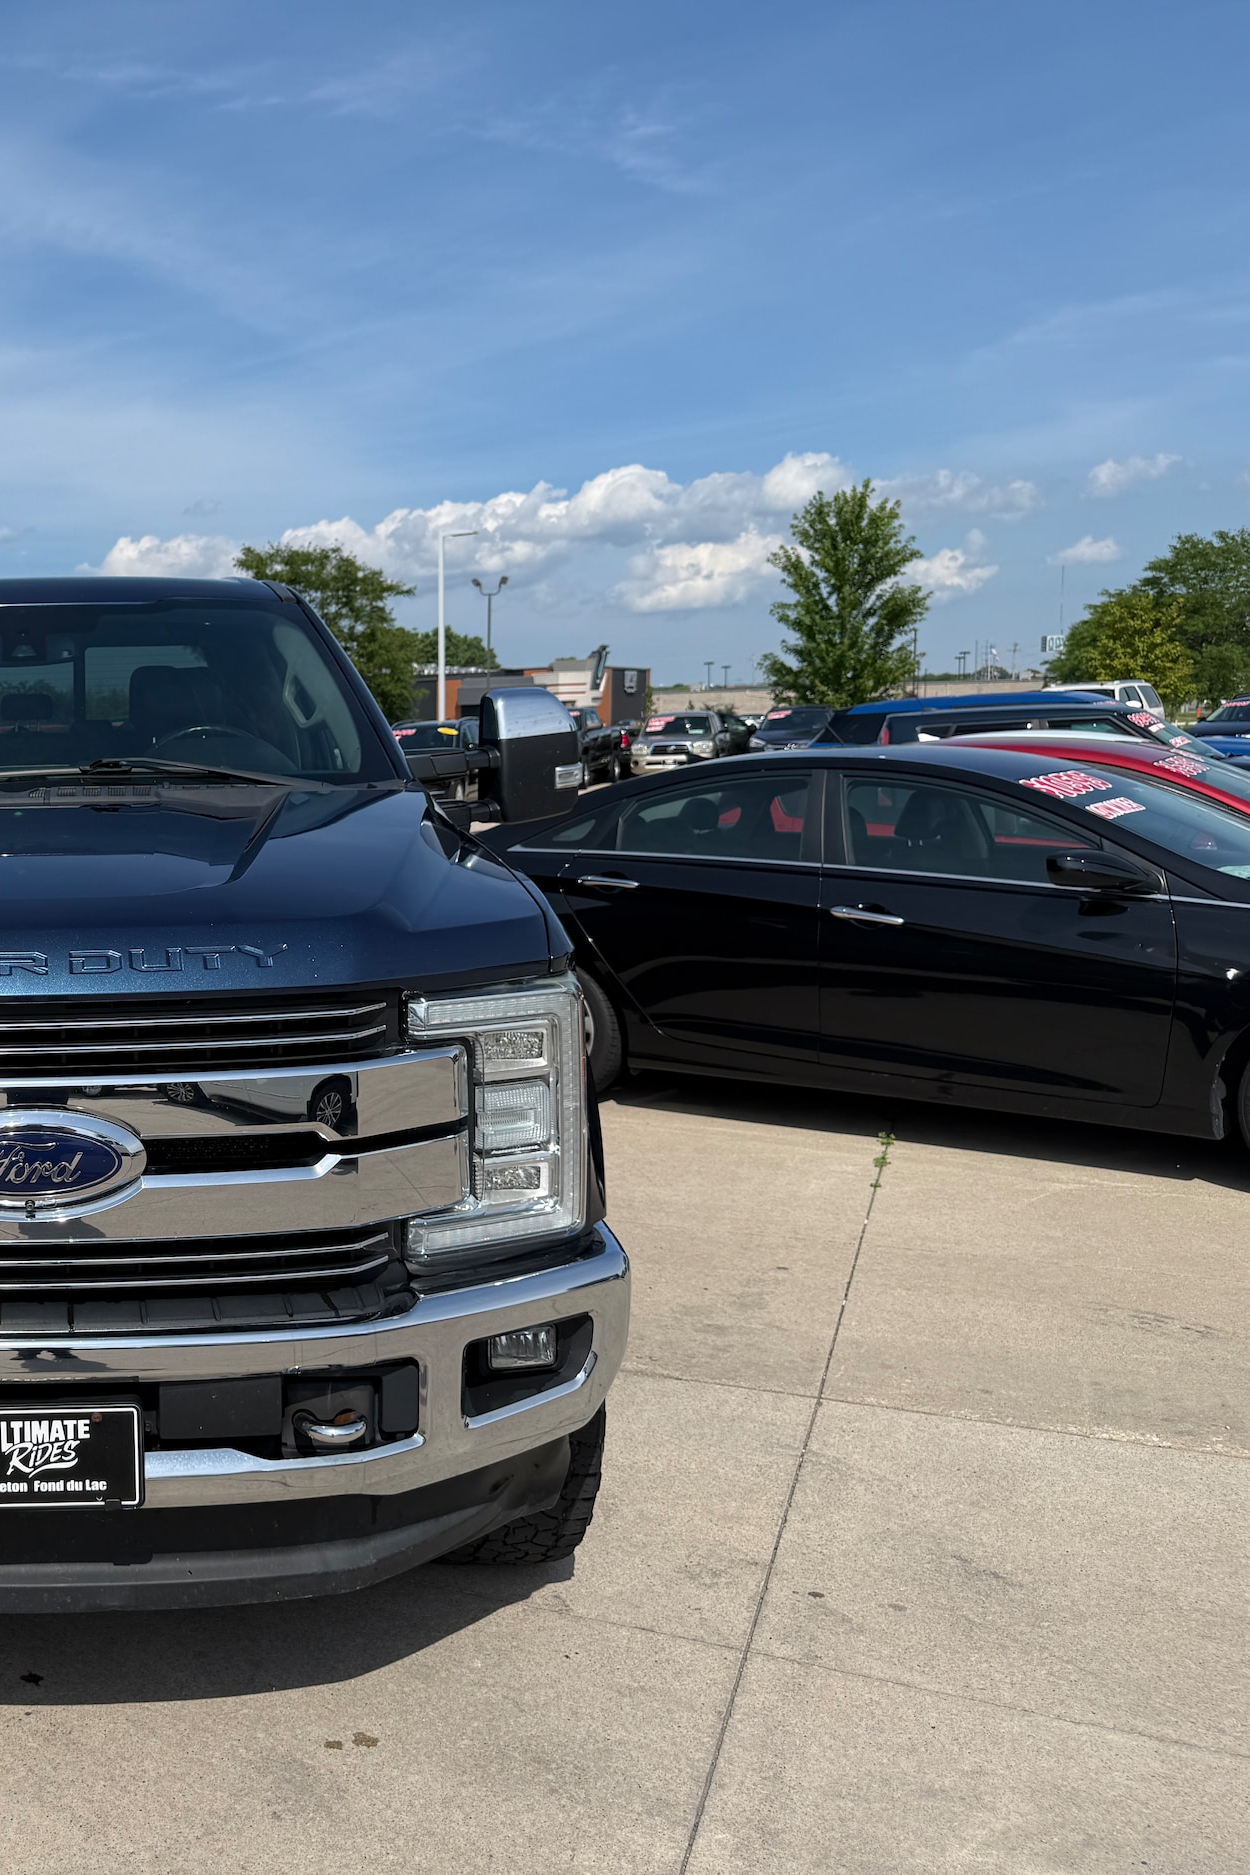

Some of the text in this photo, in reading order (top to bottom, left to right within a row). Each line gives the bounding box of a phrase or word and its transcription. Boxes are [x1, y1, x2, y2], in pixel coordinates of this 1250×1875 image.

[69, 943, 288, 974] DUTY
[34, 1480, 65, 1492] Fond
[66, 1479, 83, 1491] du
[85, 1478, 107, 1491] Lac
